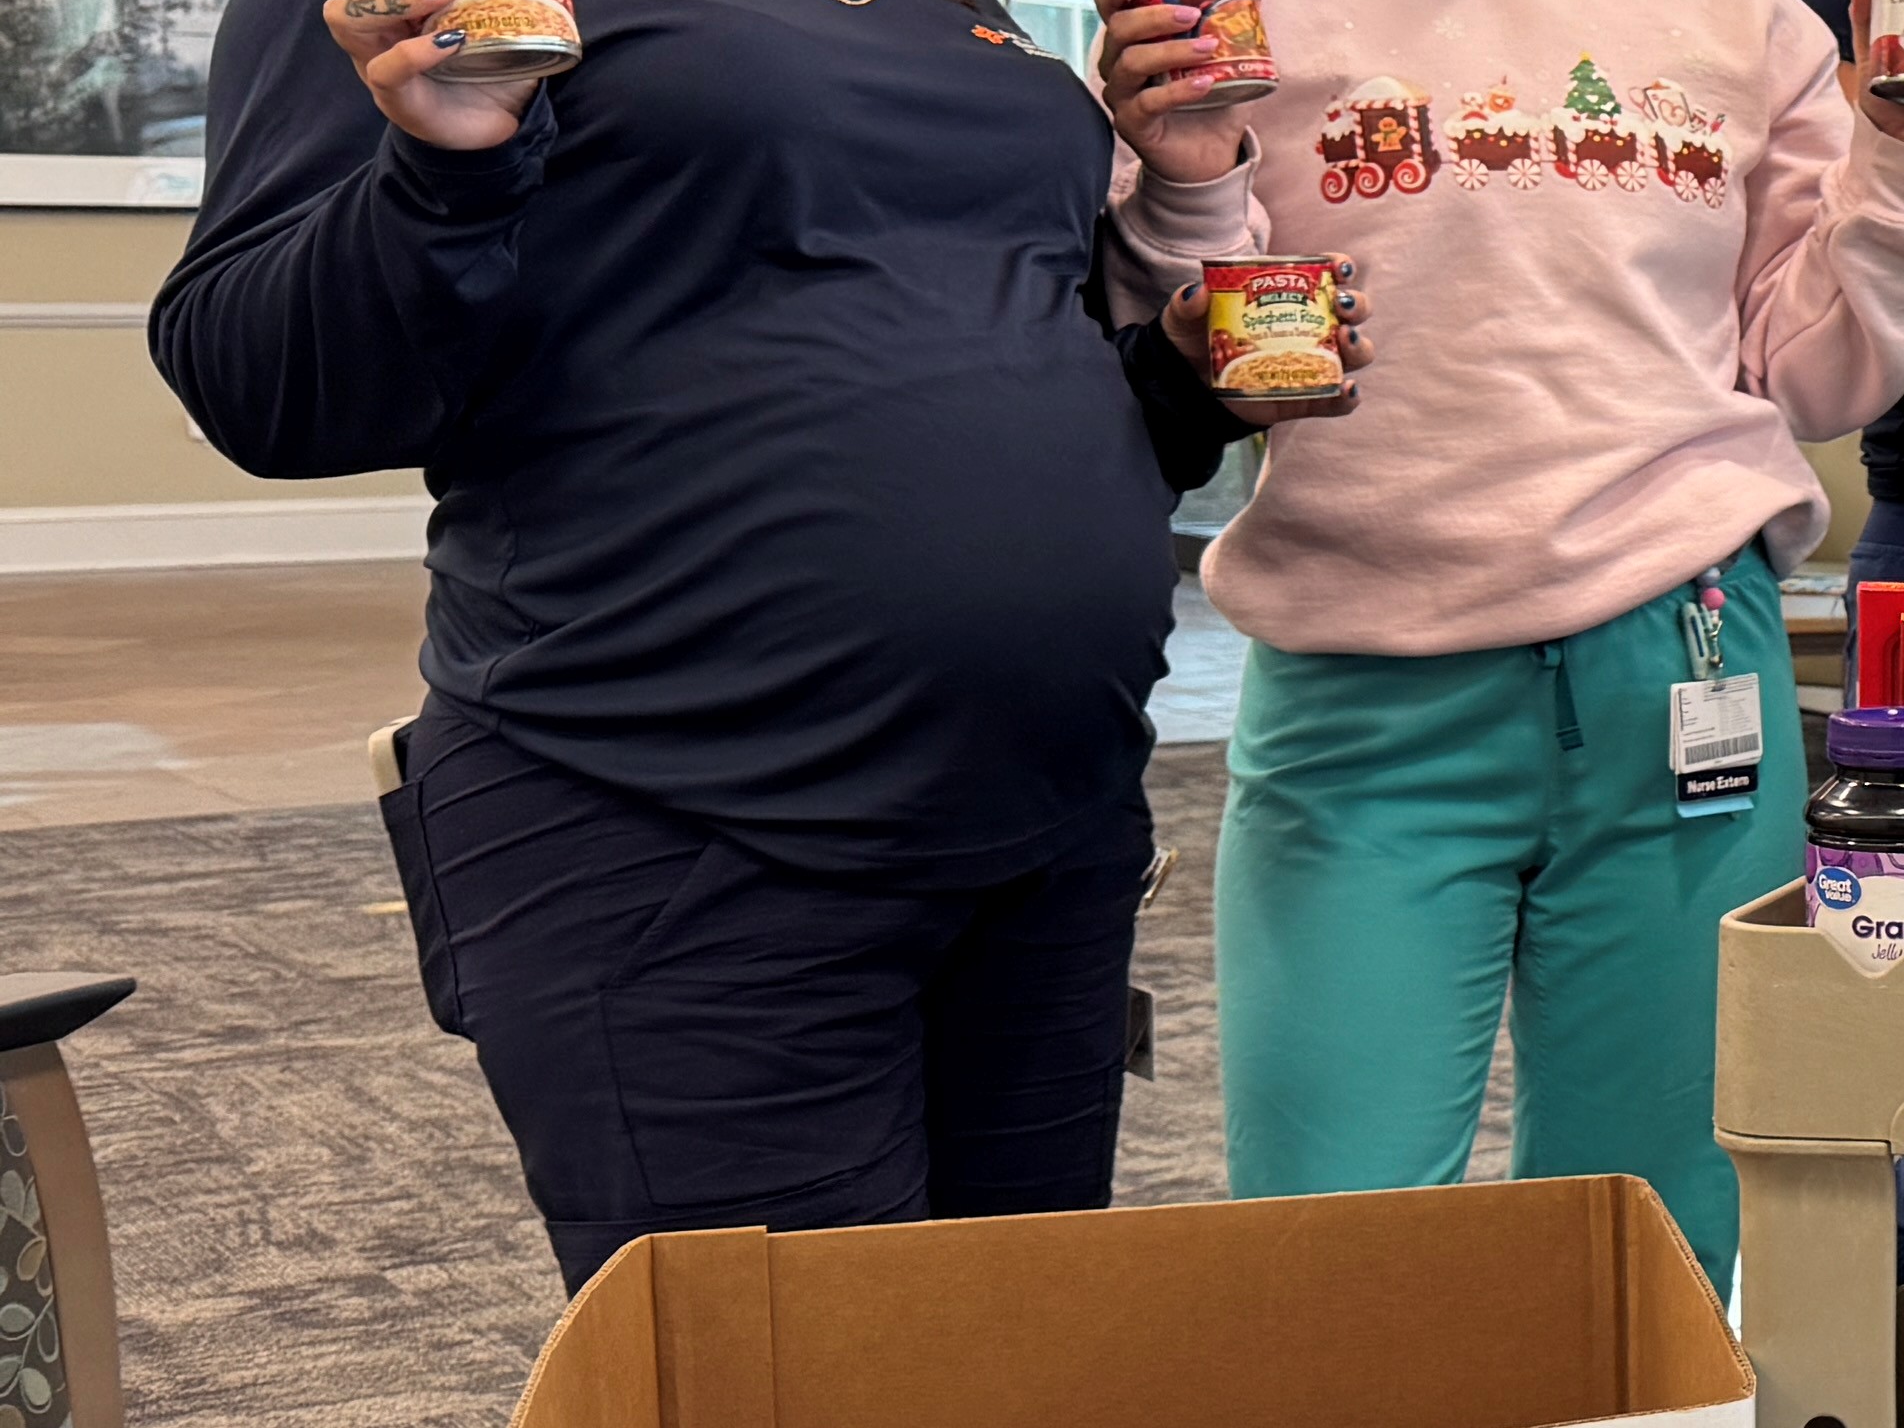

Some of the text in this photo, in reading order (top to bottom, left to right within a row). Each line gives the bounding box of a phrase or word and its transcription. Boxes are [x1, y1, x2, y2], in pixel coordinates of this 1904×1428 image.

[1252, 275, 1309, 291] PASTA
[1819, 872, 1852, 892] Great
[1825, 887, 1855, 903] Value
